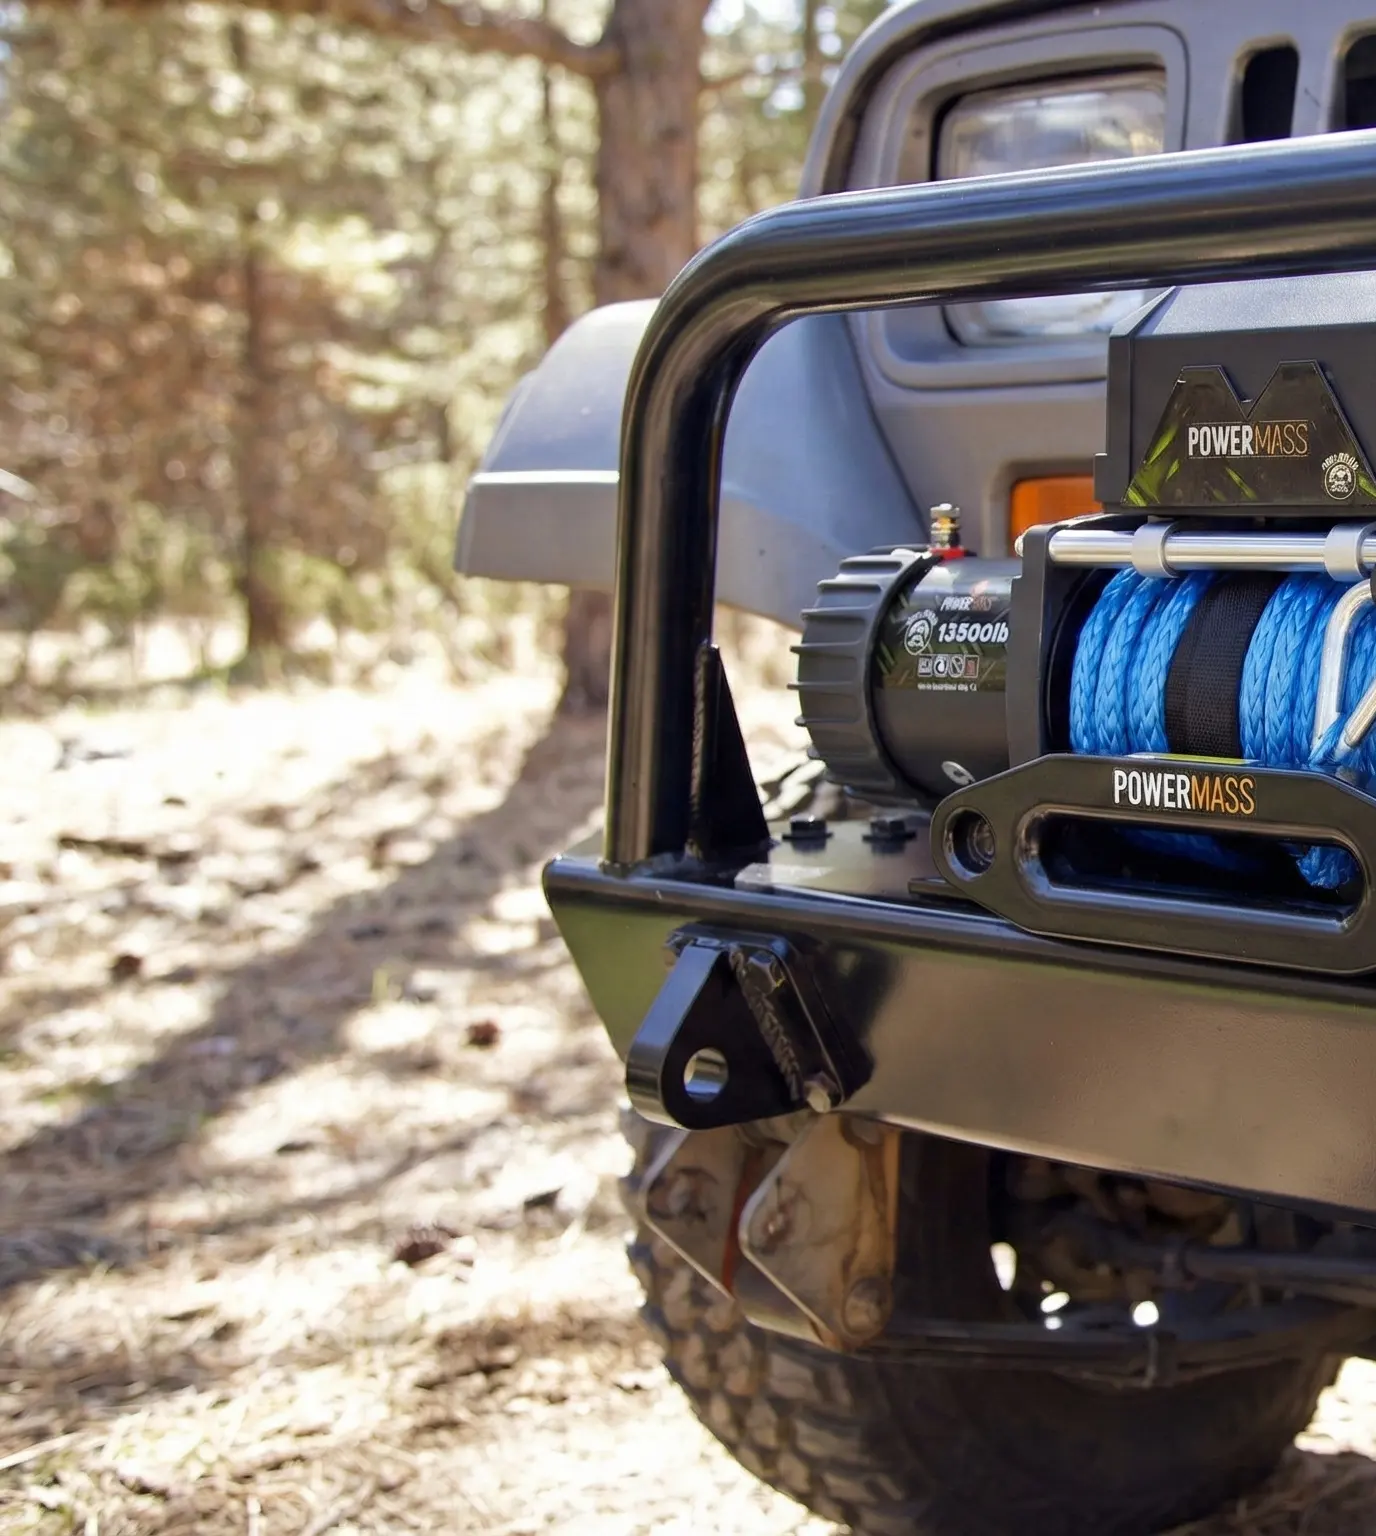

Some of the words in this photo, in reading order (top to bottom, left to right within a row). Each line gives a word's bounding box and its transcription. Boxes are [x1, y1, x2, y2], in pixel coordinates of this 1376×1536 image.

[1188, 422, 1309, 457] POWERMASS
[940, 596, 993, 612] POWER
[938, 622, 1010, 643] 13500lb
[1113, 769, 1256, 816] POWERMASS
